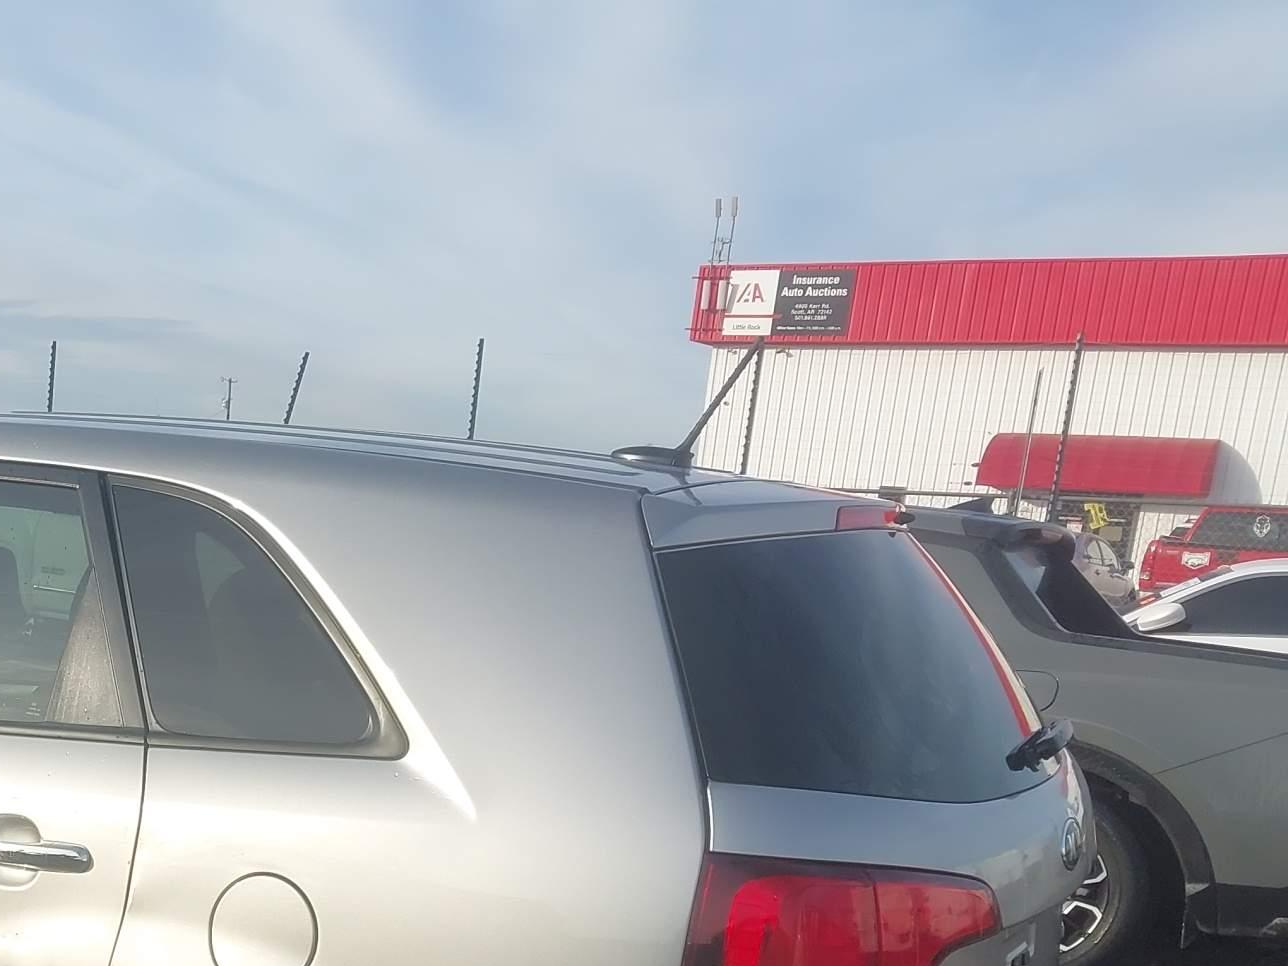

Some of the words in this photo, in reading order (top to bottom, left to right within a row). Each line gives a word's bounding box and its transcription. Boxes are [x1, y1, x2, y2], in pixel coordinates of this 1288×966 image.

[792, 274, 840, 285] Insurance
[780, 286, 804, 297] Auto
[805, 285, 848, 297] Auctions
